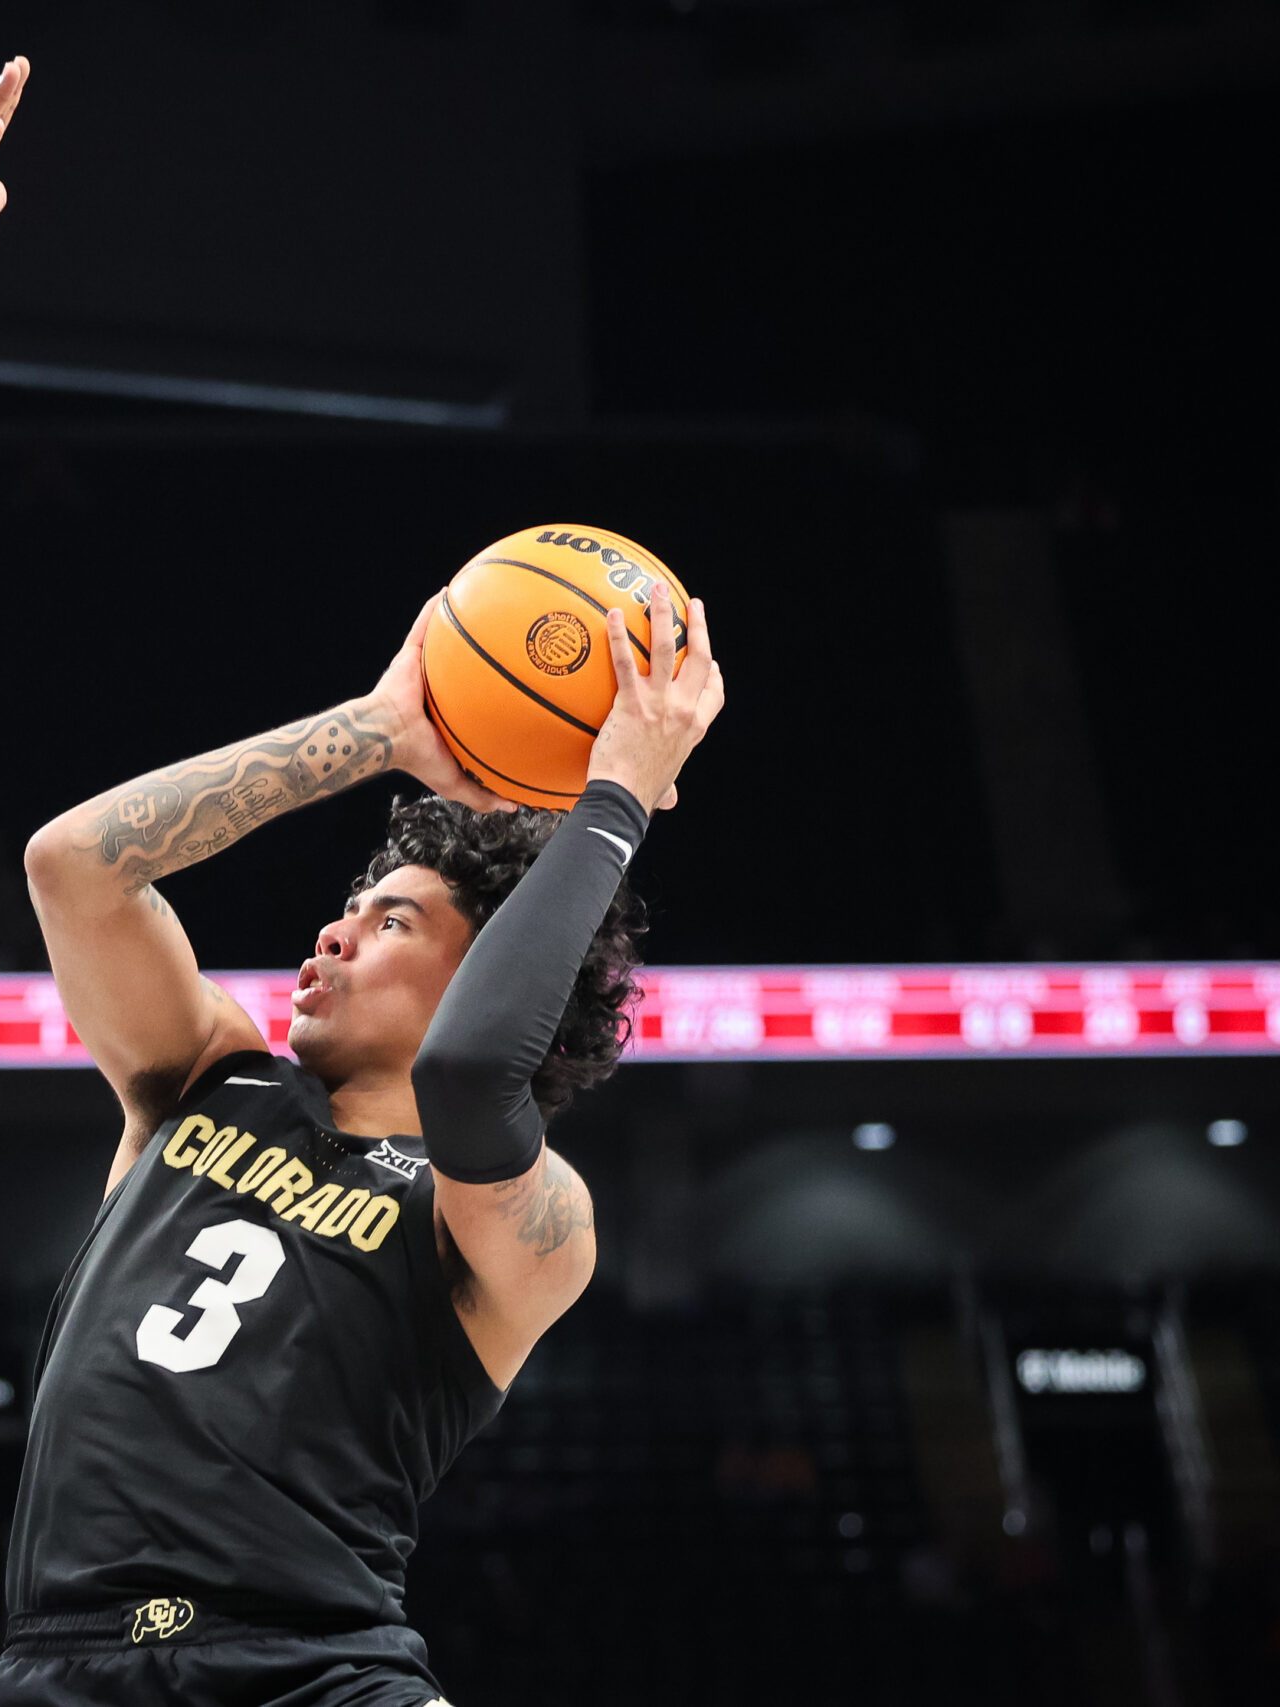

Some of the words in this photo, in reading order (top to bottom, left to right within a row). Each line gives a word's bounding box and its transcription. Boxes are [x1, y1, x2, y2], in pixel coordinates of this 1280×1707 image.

[163, 1114, 400, 1252] COLORADO
[136, 1219, 286, 1373] 3
[148, 1599, 177, 1628] CU
